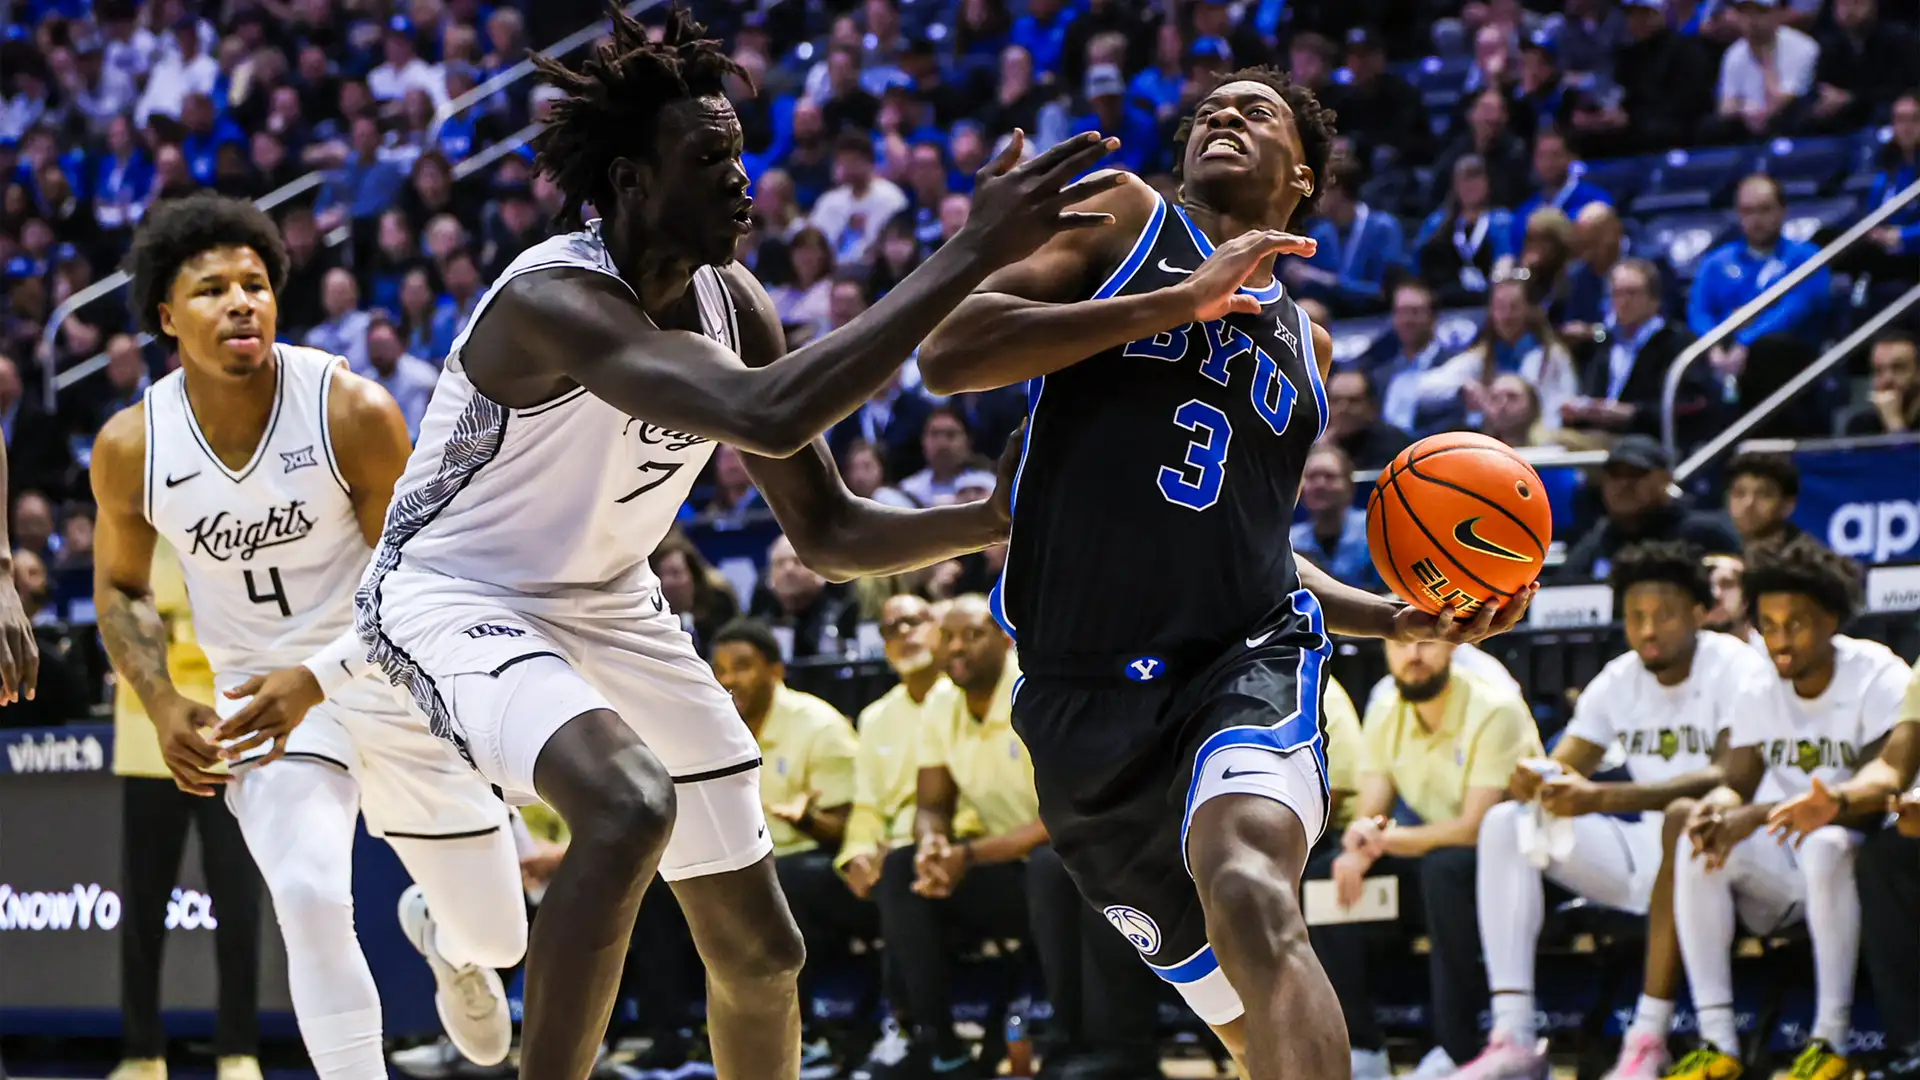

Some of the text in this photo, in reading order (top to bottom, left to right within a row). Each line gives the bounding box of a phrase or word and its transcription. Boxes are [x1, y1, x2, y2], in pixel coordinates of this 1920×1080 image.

[1122, 317, 1299, 436] BYU
[613, 460, 685, 504] 7
[1156, 398, 1233, 512] 3
[185, 499, 319, 561] Knights
[1827, 500, 1920, 563] ap
[242, 566, 292, 617] 4
[1409, 555, 1487, 614] ELITE
[1130, 659, 1159, 680] Y
